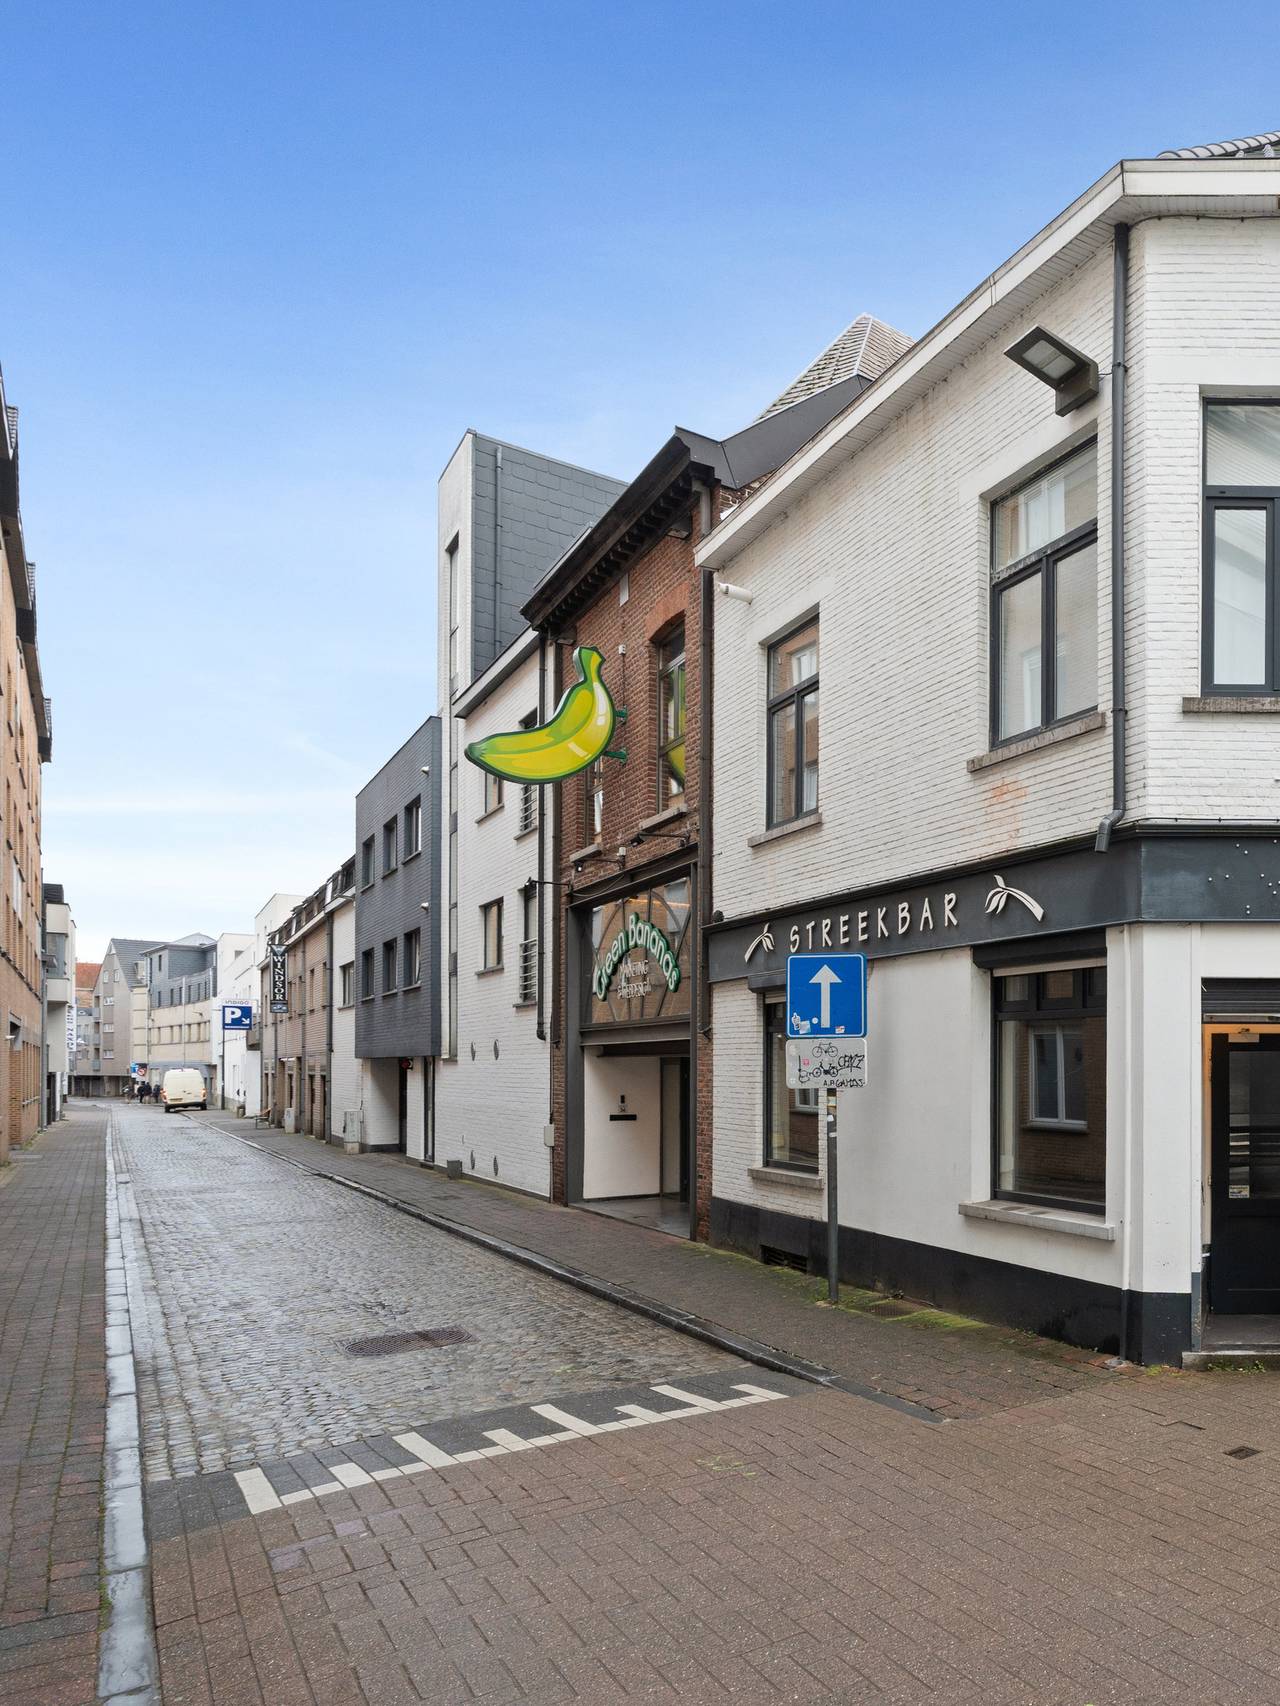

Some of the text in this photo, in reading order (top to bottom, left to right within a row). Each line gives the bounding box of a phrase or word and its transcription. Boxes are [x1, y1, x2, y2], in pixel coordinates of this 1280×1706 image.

[789, 892, 959, 953] STREEKBAR
[273, 956, 285, 1001] WINDSOR
[596, 913, 678, 1002] Green Bananas
[224, 1007, 242, 1024] P
